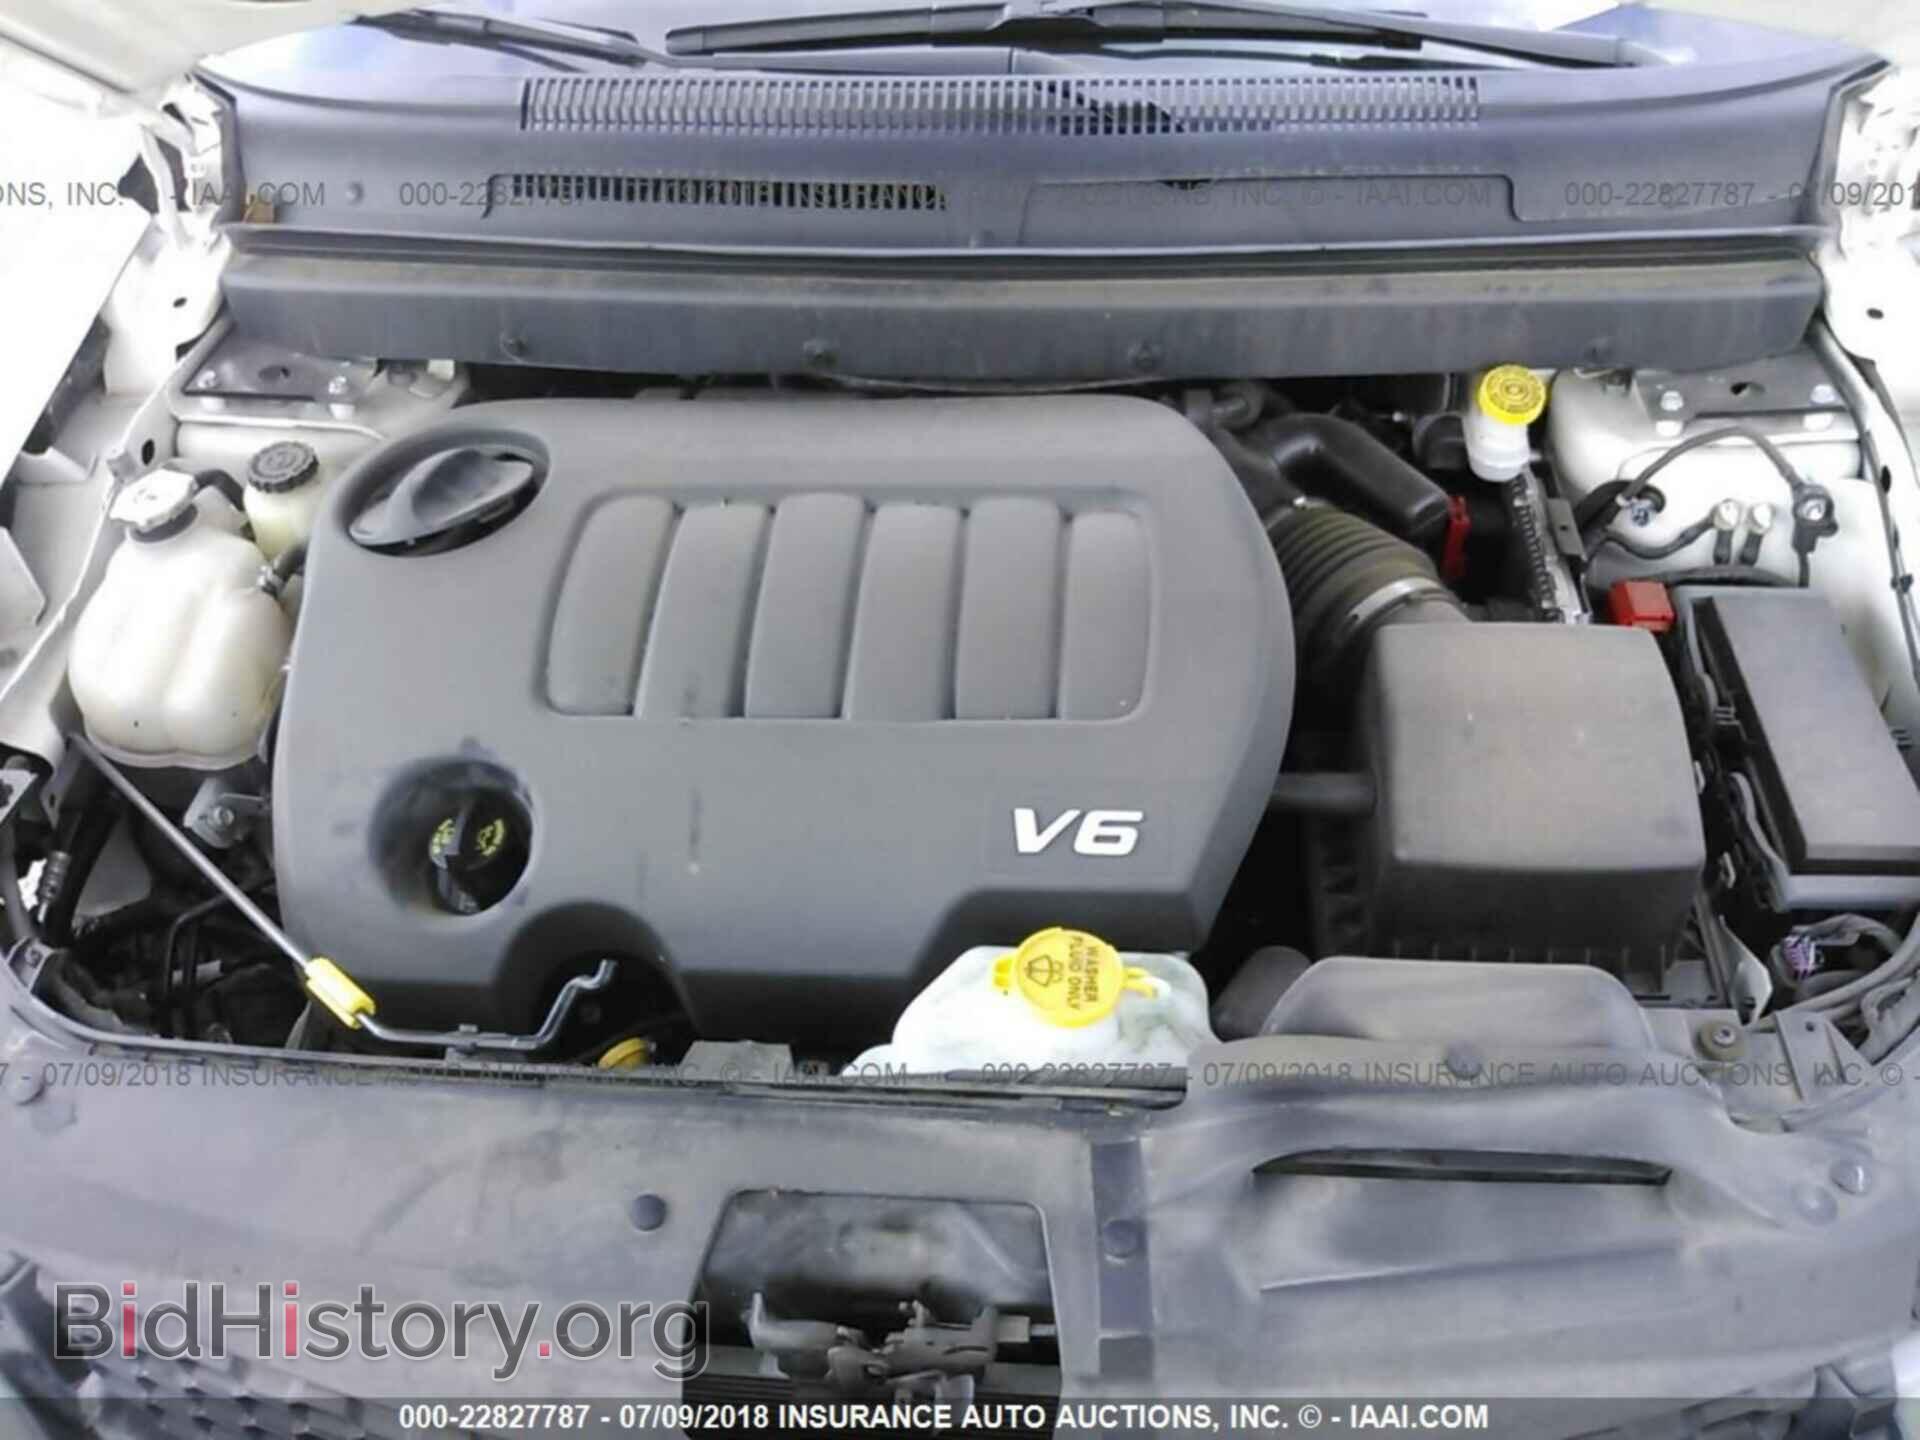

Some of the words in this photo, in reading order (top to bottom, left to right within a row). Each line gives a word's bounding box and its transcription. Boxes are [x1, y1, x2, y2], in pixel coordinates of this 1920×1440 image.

[1013, 808, 1144, 856] V6
[1068, 936, 1083, 972] FLUID
[1083, 946, 1099, 1002] WASHER
[1066, 976, 1082, 1010] ONLY
